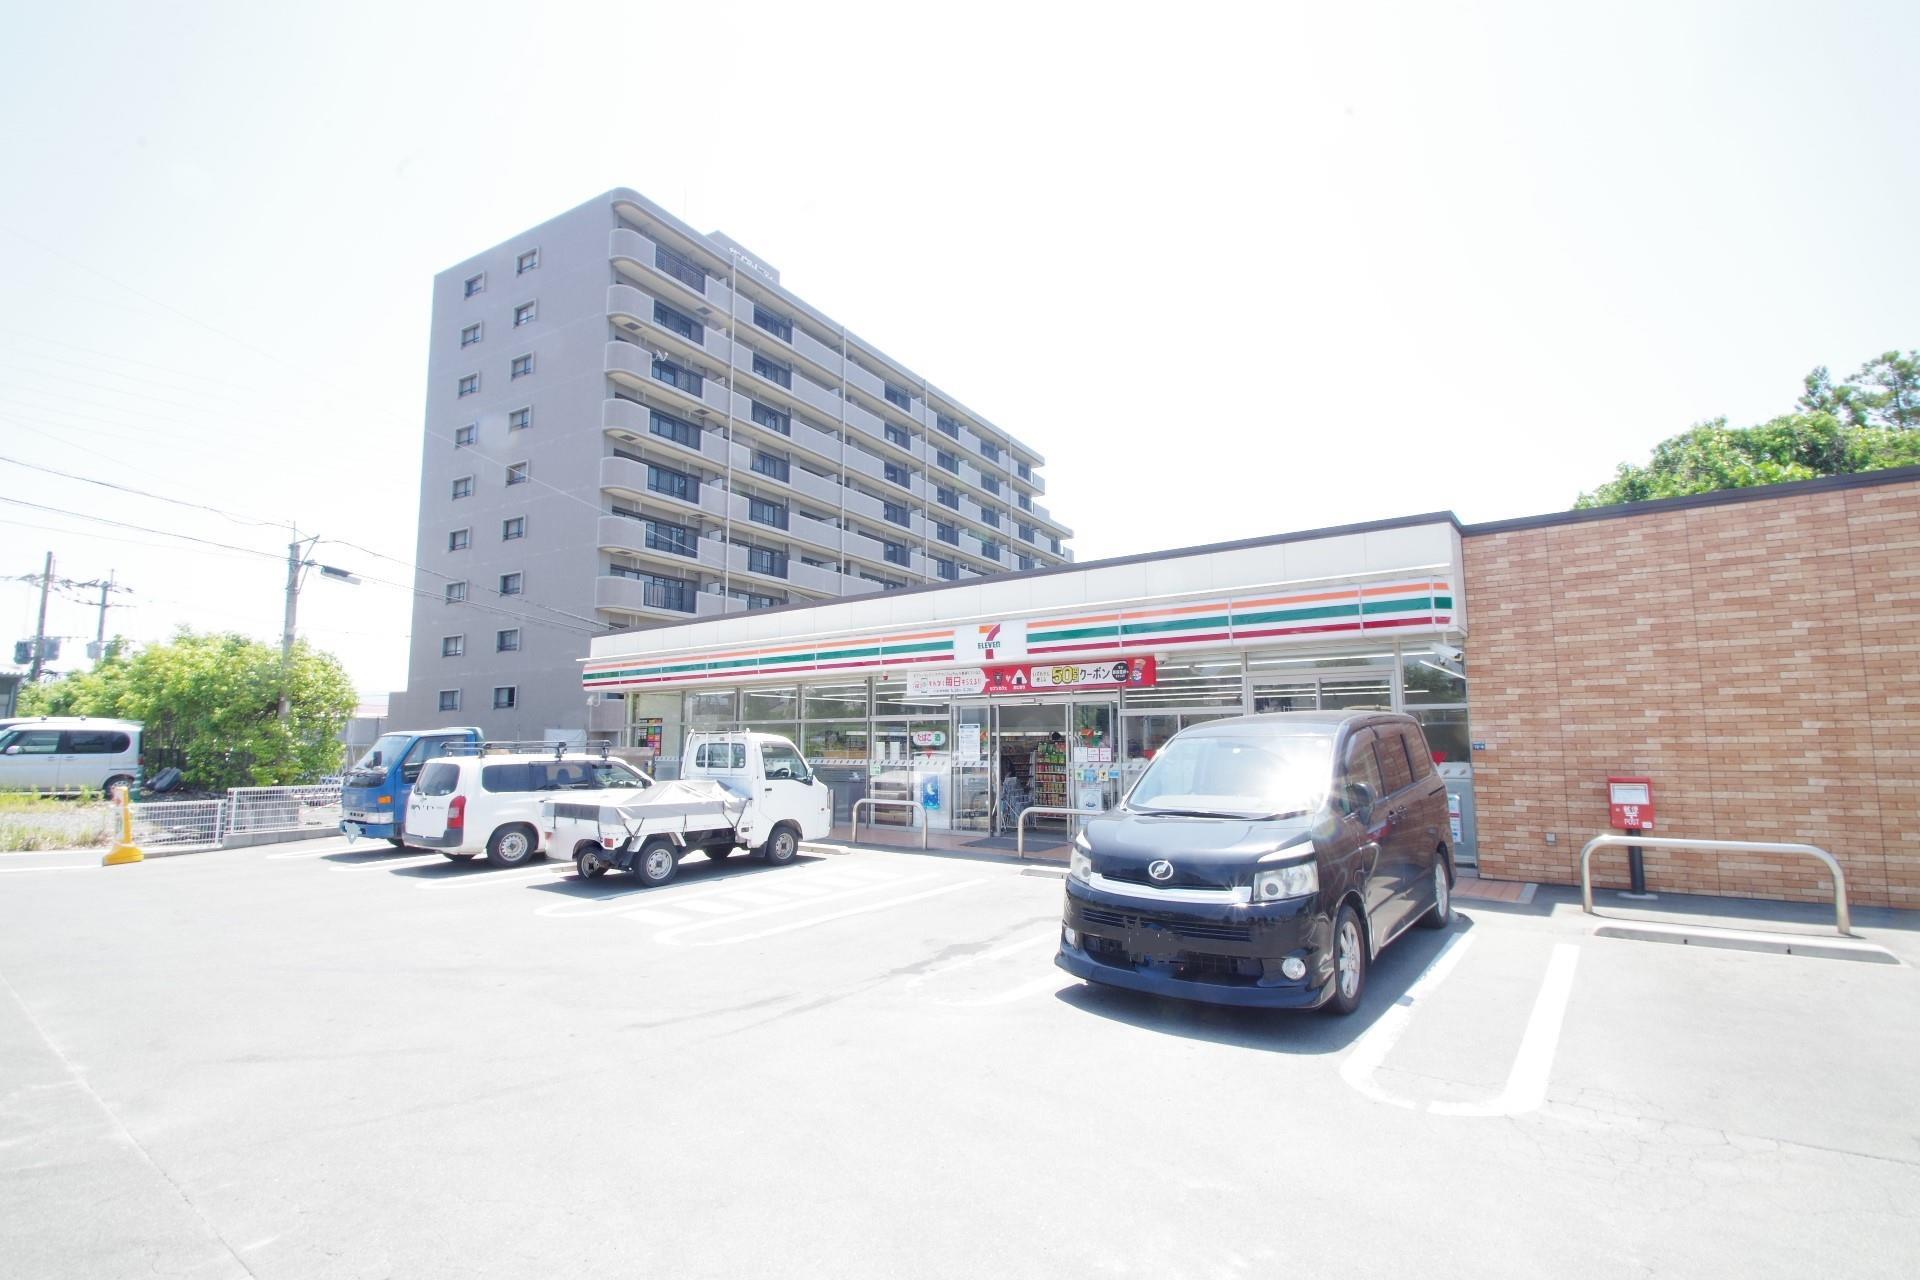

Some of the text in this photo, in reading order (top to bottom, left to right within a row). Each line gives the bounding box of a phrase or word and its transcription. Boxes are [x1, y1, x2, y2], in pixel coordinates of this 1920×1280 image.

[1052, 666, 1073, 685] 50
[1079, 666, 1111, 681] クーポン
[917, 733, 932, 742] たばこ
[1624, 818, 1640, 826] POST
